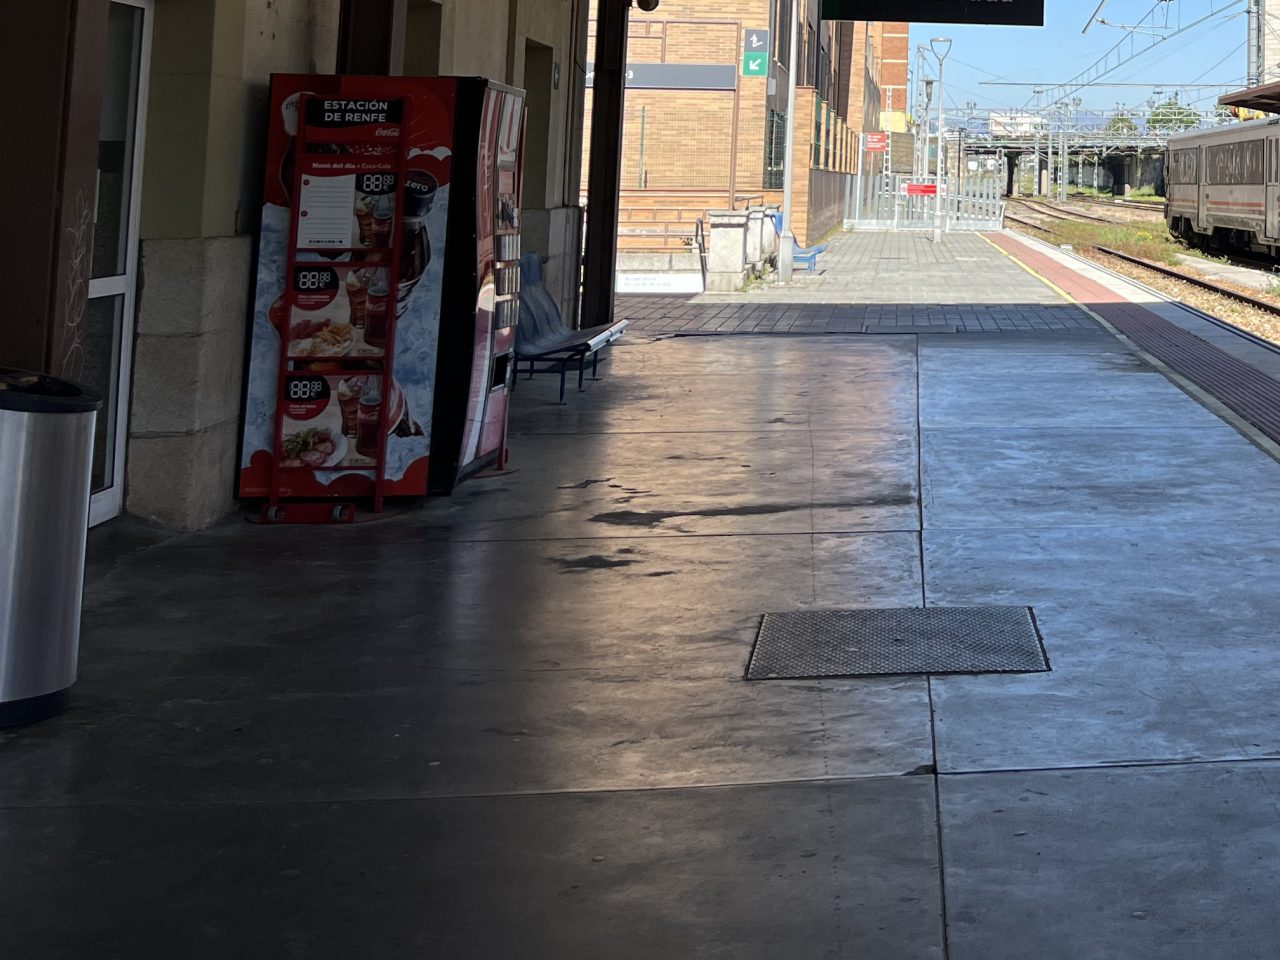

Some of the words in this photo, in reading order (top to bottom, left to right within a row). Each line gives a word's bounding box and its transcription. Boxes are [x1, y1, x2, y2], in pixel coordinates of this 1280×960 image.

[323, 99, 389, 111] ESTACIÓN
[324, 112, 342, 122] DE
[344, 112, 387, 123] RENFE
[405, 178, 429, 192] zero
